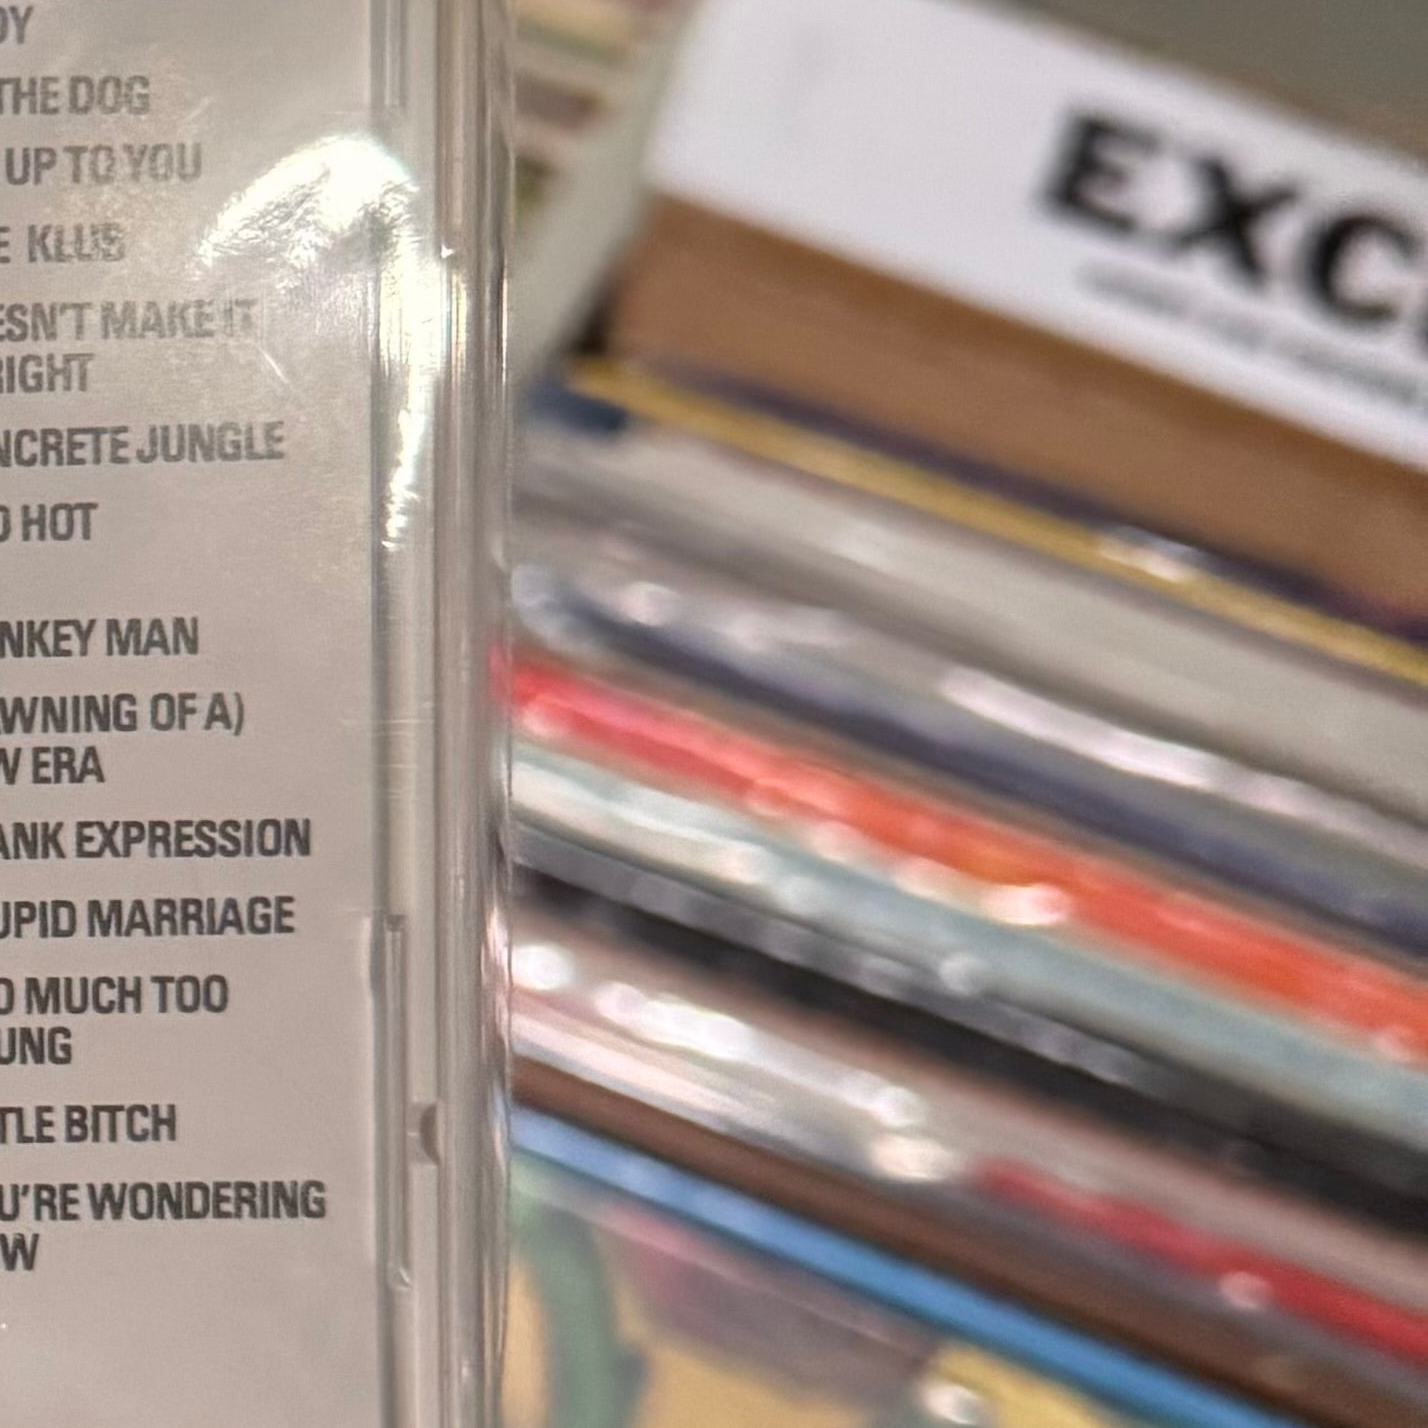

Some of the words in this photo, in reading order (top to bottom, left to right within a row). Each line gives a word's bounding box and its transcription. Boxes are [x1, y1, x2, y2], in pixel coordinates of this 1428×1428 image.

[68, 75, 151, 114] DOG
[5, 146, 55, 186] UP
[59, 145, 115, 185] TO
[123, 142, 203, 182] YOU
[1036, 107, 1428, 372] EXC
[101, 299, 215, 340] MAKE
[223, 298, 258, 337] IT
[136, 420, 286, 463] JUNGLE
[22, 502, 98, 542] HOT
[106, 616, 199, 656] MAN
[148, 692, 198, 733] OF
[203, 691, 244, 737] A)
[31, 747, 104, 784] ERA
[75, 818, 311, 860] EXPRESSION
[87, 896, 295, 938] MARRIAGE
[24, 975, 143, 1015] MUCH
[152, 973, 228, 1013] TOO
[65, 1104, 176, 1144] BITCH
[85, 1181, 326, 1220] WONDERING
